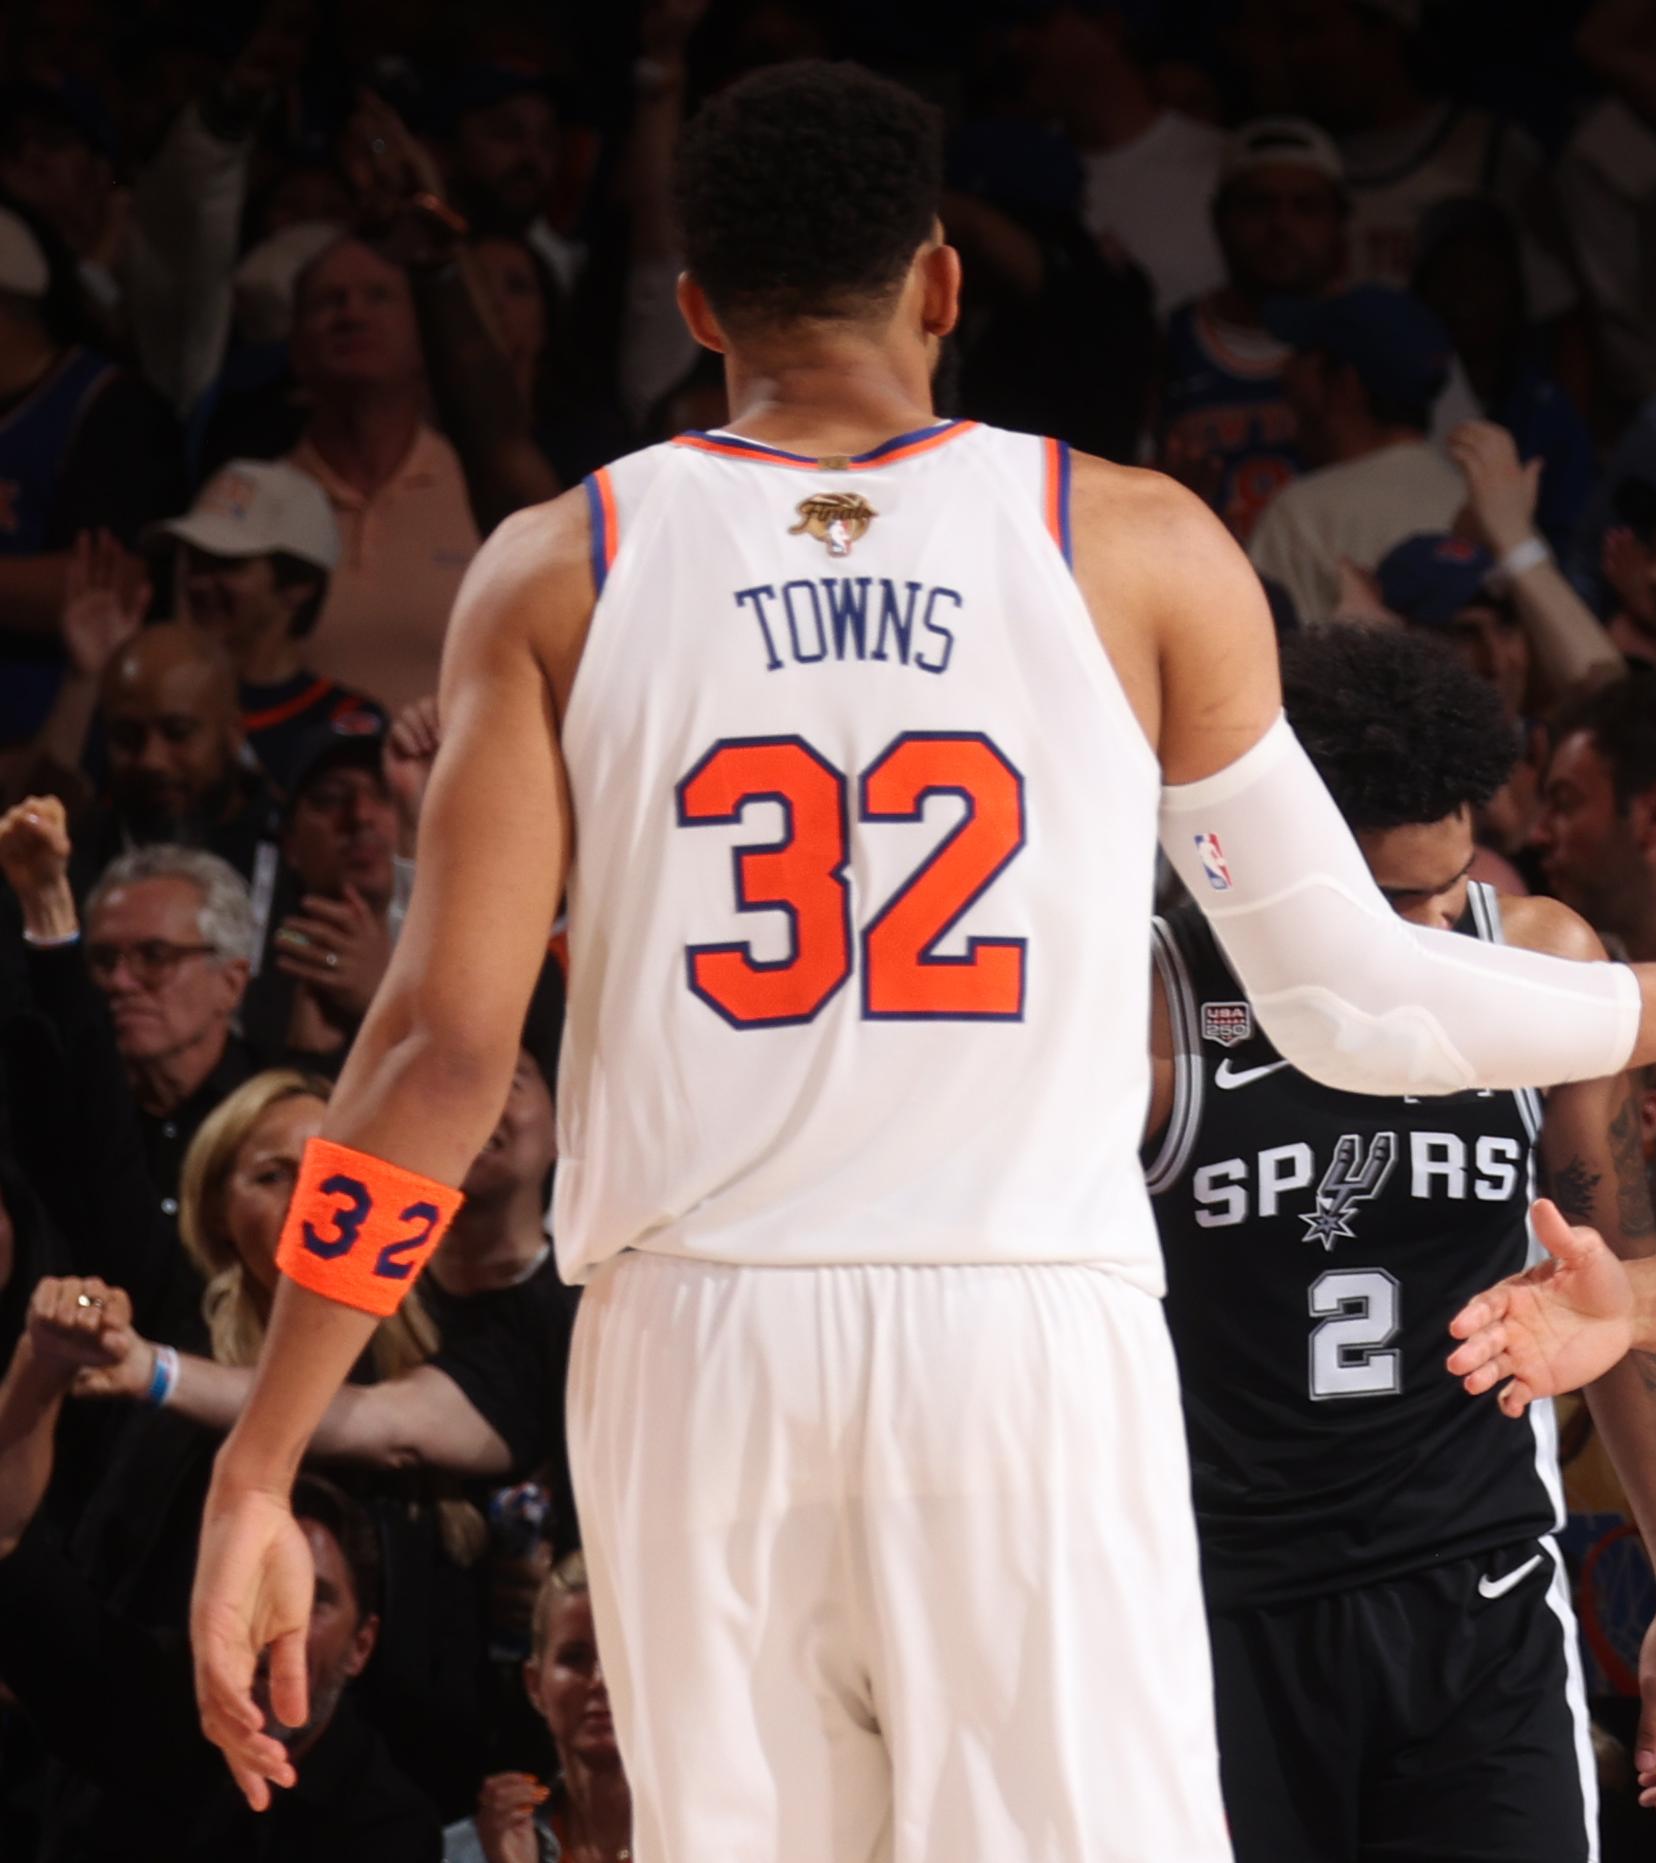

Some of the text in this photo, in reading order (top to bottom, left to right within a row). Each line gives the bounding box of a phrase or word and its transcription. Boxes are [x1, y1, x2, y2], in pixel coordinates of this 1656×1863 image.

[734, 577, 962, 674] TOWNS
[675, 731, 1027, 1030] 32
[1206, 1008, 1245, 1018] USA
[302, 1173, 440, 1280] 32
[1193, 1131, 1521, 1250] SPURS
[1308, 1266, 1403, 1401] 2
